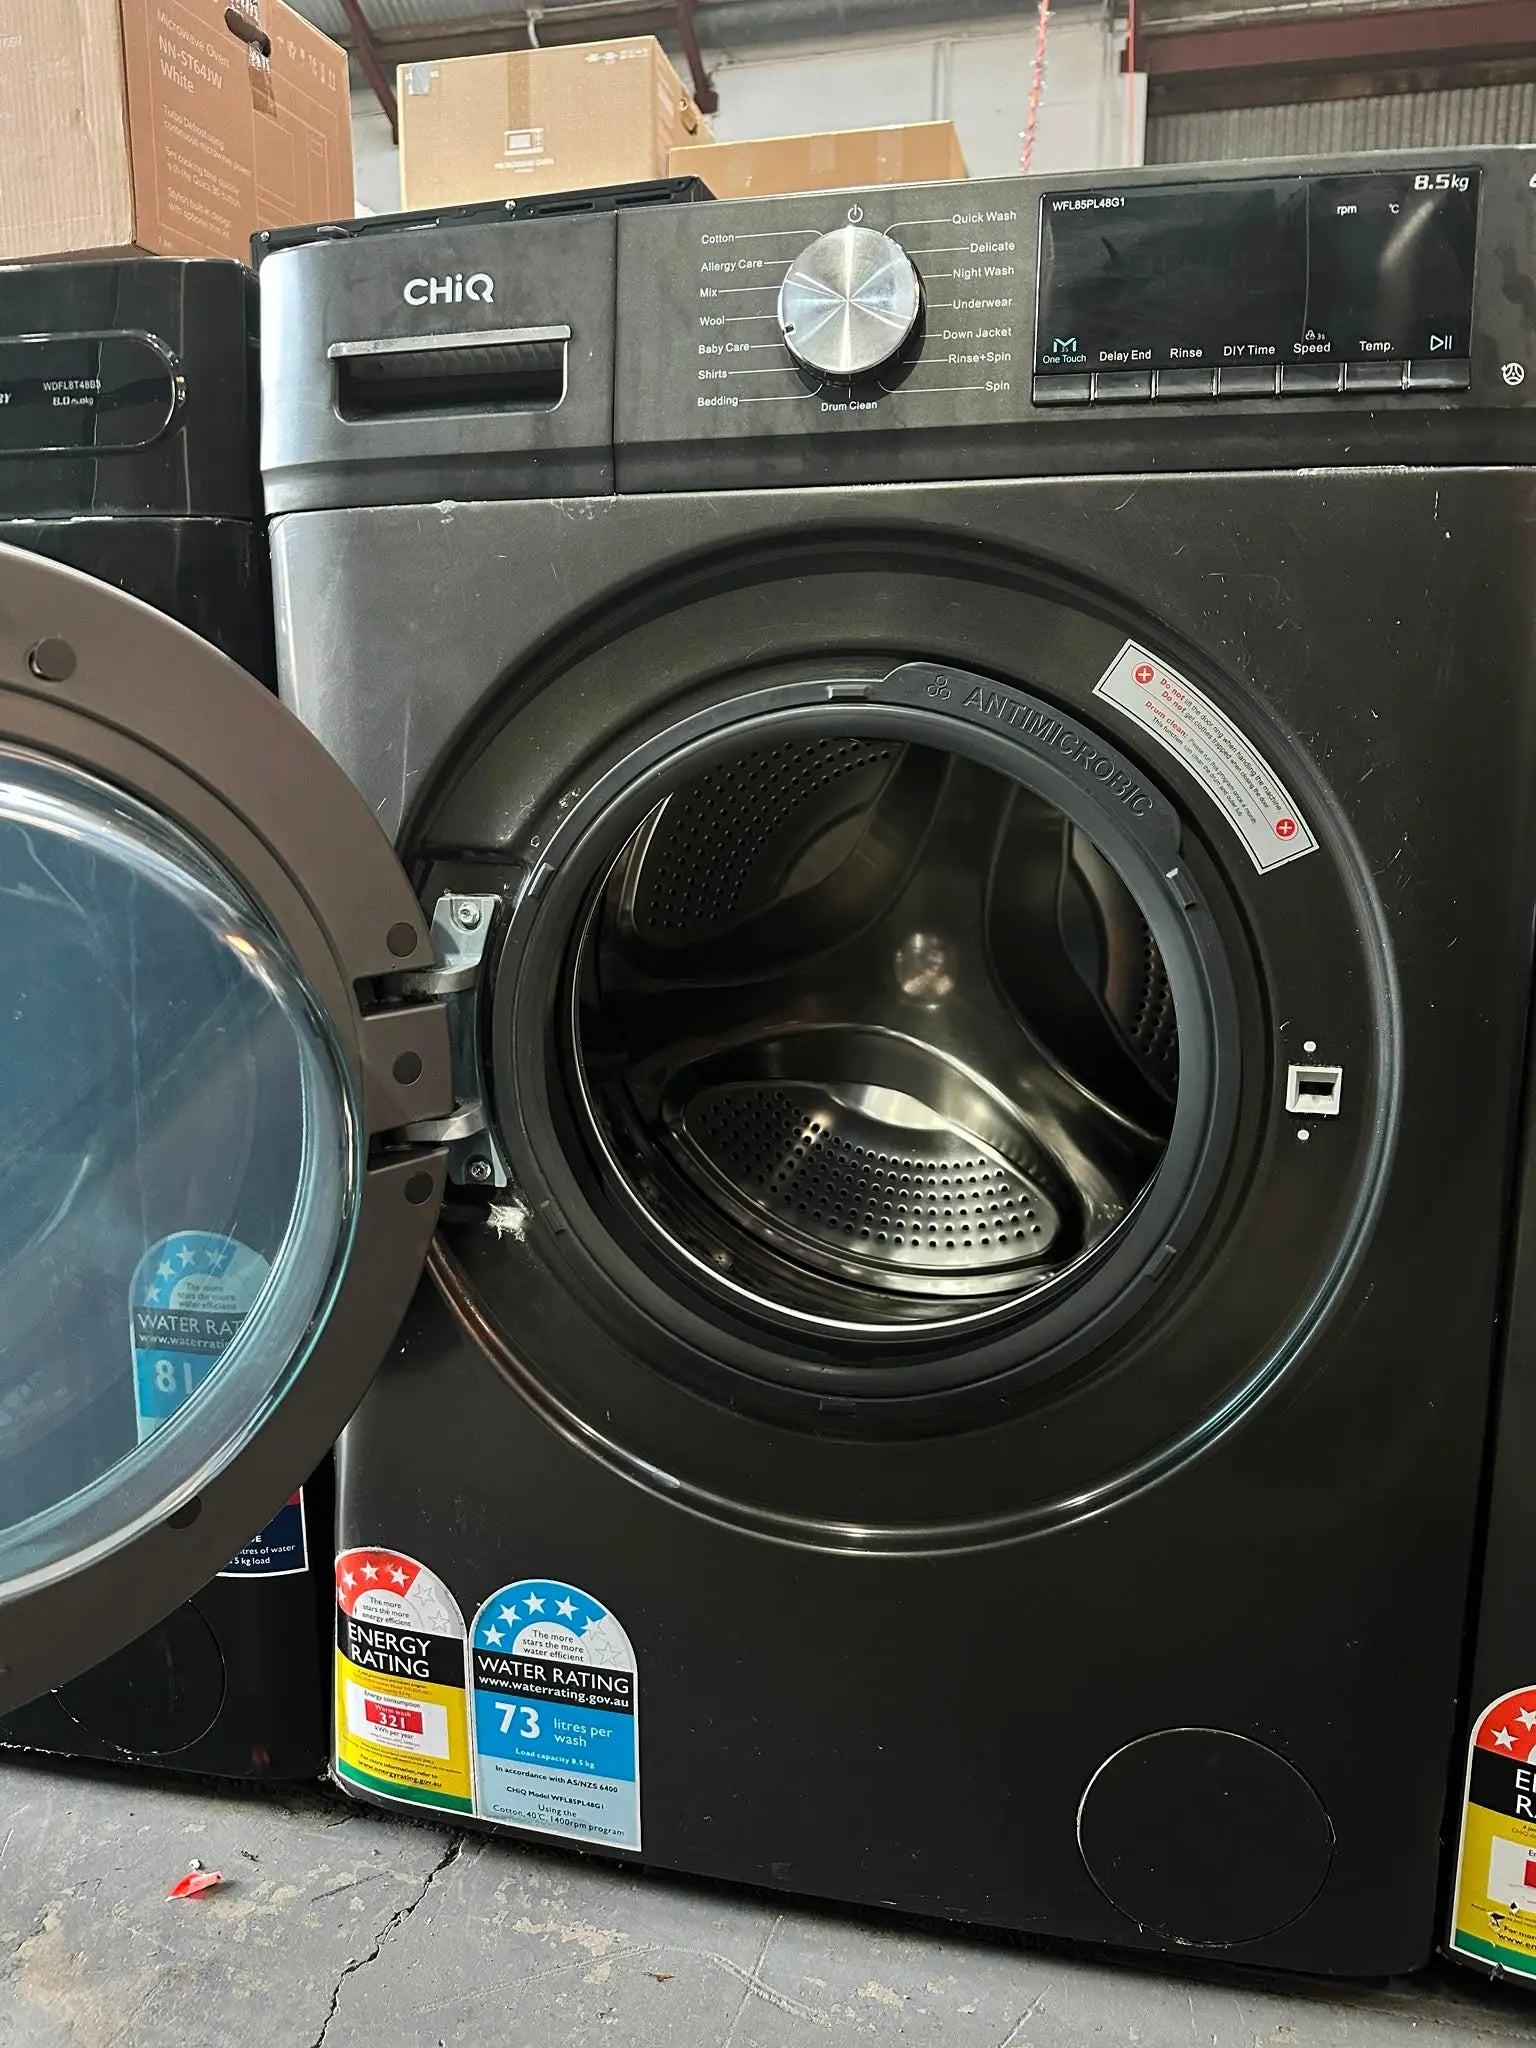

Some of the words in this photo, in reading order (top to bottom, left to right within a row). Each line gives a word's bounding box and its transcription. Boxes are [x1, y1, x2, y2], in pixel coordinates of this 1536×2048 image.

[157, 8, 205, 52] Microwave
[206, 43, 229, 68] Oven
[159, 35, 222, 89] NN-ST64JW
[160, 59, 194, 93] White
[1052, 197, 1125, 211] WFL85PL48G1
[1336, 204, 1358, 216] rpm
[952, 212, 984, 225] Quick
[986, 210, 1017, 222] Wash
[701, 232, 735, 245] Cotton
[970, 240, 1015, 253] Delicate
[701, 260, 739, 274] Allergy
[739, 258, 763, 270] Care
[953, 267, 983, 280] Night
[984, 265, 1015, 277] Wash
[403, 273, 494, 306] CHiQ
[700, 286, 717, 298] Mix
[953, 297, 1013, 310] Underwear
[699, 316, 725, 326] Wool
[943, 328, 973, 340] Down
[976, 326, 1012, 339] Jacket
[698, 344, 724, 357] Baby
[725, 342, 750, 353] Care
[1170, 348, 1203, 359] Rinse
[1223, 345, 1246, 356] DIY
[1248, 344, 1276, 356] Time
[1293, 341, 1331, 355] Speed
[1359, 340, 1395, 353] Temp.
[948, 351, 1012, 365] Rinse+Spin
[1042, 354, 1060, 364] One
[1062, 353, 1087, 364] Touch
[1099, 350, 1129, 363] Delay
[1131, 349, 1152, 360] End
[698, 368, 728, 380] Shirts
[985, 380, 1010, 393] Spin
[697, 395, 739, 409] Bedding
[821, 402, 848, 412] Drum
[849, 400, 878, 411] Clean
[1160, 678, 1171, 690] Do
[1171, 688, 1185, 702] not
[1192, 705, 1201, 715] the
[1201, 714, 1214, 728] door
[1212, 726, 1224, 739] ring
[1223, 737, 1237, 753] when
[1236, 751, 1257, 777] handling
[1255, 775, 1264, 787] the
[962, 685, 1155, 819] ANTIMICROBIC
[1162, 690, 1172, 702] Do
[1173, 701, 1187, 714] not
[1184, 712, 1196, 722] get
[1194, 720, 1213, 740] clothes
[1212, 737, 1232, 760] trapped
[1230, 759, 1241, 773] when
[1240, 771, 1254, 790] closing
[1253, 787, 1261, 798] the
[1260, 796, 1269, 809] door
[1145, 700, 1166, 719] Drum
[1166, 718, 1189, 738] clean:
[1203, 754, 1212, 763] run
[1217, 770, 1235, 792] program
[1233, 790, 1243, 804] once
[1244, 807, 1257, 824] month
[1152, 717, 1164, 728] This
[1163, 725, 1184, 745] function
[1203, 764, 1211, 774] the
[1209, 772, 1221, 785] drum
[1219, 785, 1228, 795] and
[1235, 807, 1243, 817] tub
[137, 1313, 200, 1334] WATER
[260, 1546, 269, 1555] of
[270, 1544, 296, 1553] water
[241, 1557, 251, 1566] kg
[369, 1596, 382, 1606] The
[383, 1600, 402, 1609] more
[363, 1604, 378, 1613] stars
[379, 1606, 390, 1615] the
[391, 1609, 409, 1619] more
[362, 1612, 384, 1624] energy
[385, 1617, 411, 1627] efficient
[348, 1621, 431, 1657] ENERGY
[532, 1629, 549, 1640] The
[551, 1633, 574, 1643] more
[522, 1638, 543, 1648] stars
[545, 1640, 559, 1650] the
[561, 1644, 584, 1654] more
[351, 1643, 430, 1678] RATING
[523, 1647, 548, 1657] water
[550, 1651, 584, 1662] efficient
[478, 1655, 547, 1681] WATER
[553, 1667, 629, 1694] RATING
[478, 1675, 629, 1708] www.waterrating.gov.au
[364, 1690, 382, 1702] Energy
[383, 1695, 421, 1709] consumption
[379, 1711, 406, 1729] 321
[494, 1701, 540, 1739] 73
[389, 1729, 399, 1737] per
[553, 1717, 587, 1734] litres
[590, 1725, 613, 1739] per
[554, 1734, 587, 1748] wash
[515, 1747, 535, 1758] Load
[537, 1753, 570, 1765] capacity
[585, 1760, 595, 1770] kg
[505, 1766, 548, 1780] accordance
[549, 1775, 566, 1785] with
[566, 1778, 598, 1790] AS/NZS
[599, 1784, 618, 1793] 6400
[528, 1788, 550, 1800] Model
[538, 1803, 561, 1816] Using
[563, 1808, 577, 1818] the
[550, 1816, 587, 1830] 1400rpm
[588, 1822, 625, 1836] program
[1504, 1925, 1517, 1934] For
